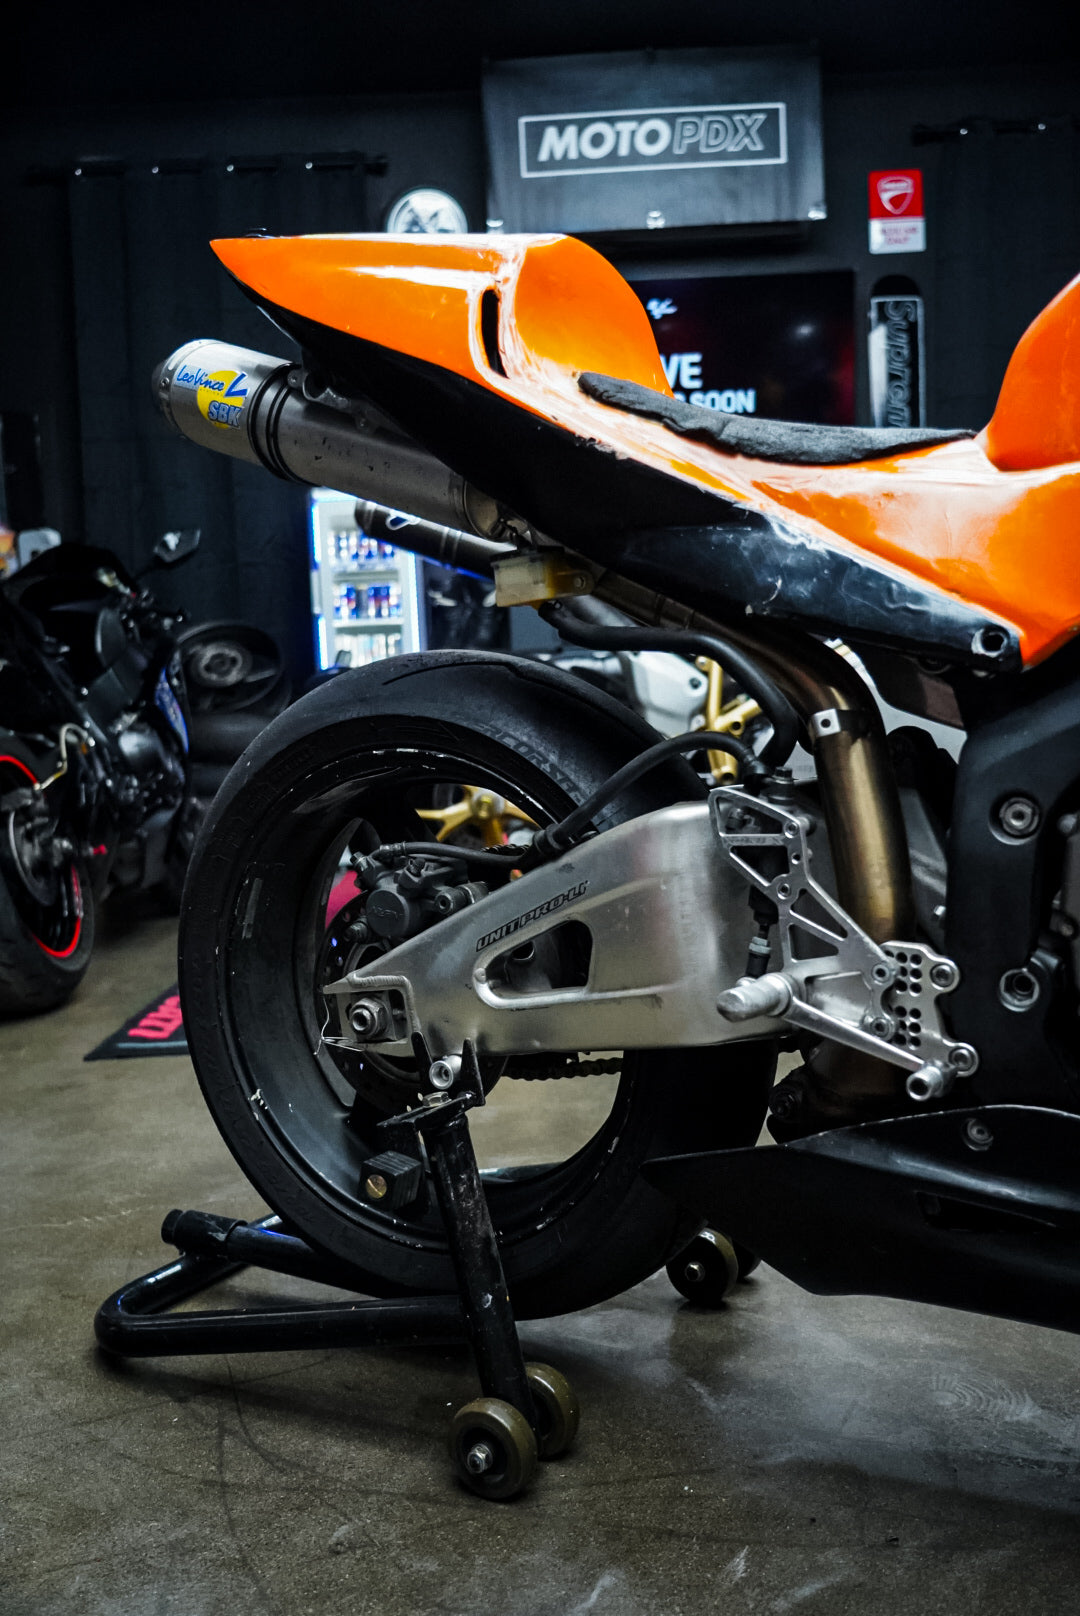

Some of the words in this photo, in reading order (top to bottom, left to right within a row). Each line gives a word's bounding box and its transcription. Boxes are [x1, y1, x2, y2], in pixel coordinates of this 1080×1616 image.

[537, 112, 768, 162] MOTOPDX
[177, 364, 225, 392] LeoVince
[208, 400, 242, 427] SBK
[476, 917, 520, 952] UNIT
